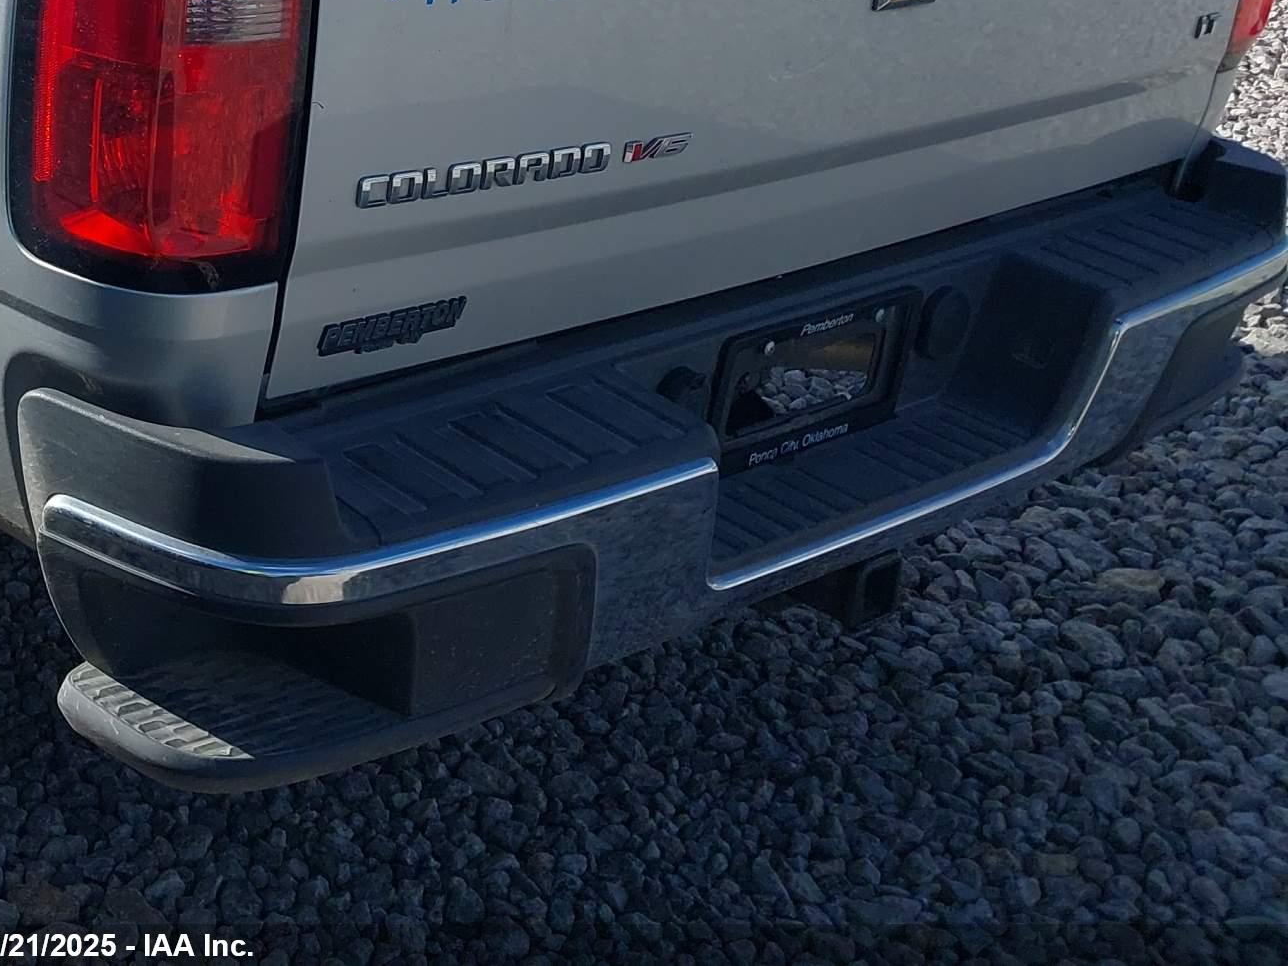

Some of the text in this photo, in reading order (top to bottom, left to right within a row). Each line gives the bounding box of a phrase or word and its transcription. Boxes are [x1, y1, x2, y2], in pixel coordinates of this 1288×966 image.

[355, 141, 612, 209] COLORADO
[317, 296, 467, 355] PEMBERTON
[799, 313, 854, 336] Pemberton
[748, 447, 778, 466] Ponca
[802, 423, 849, 447] Oklahoma
